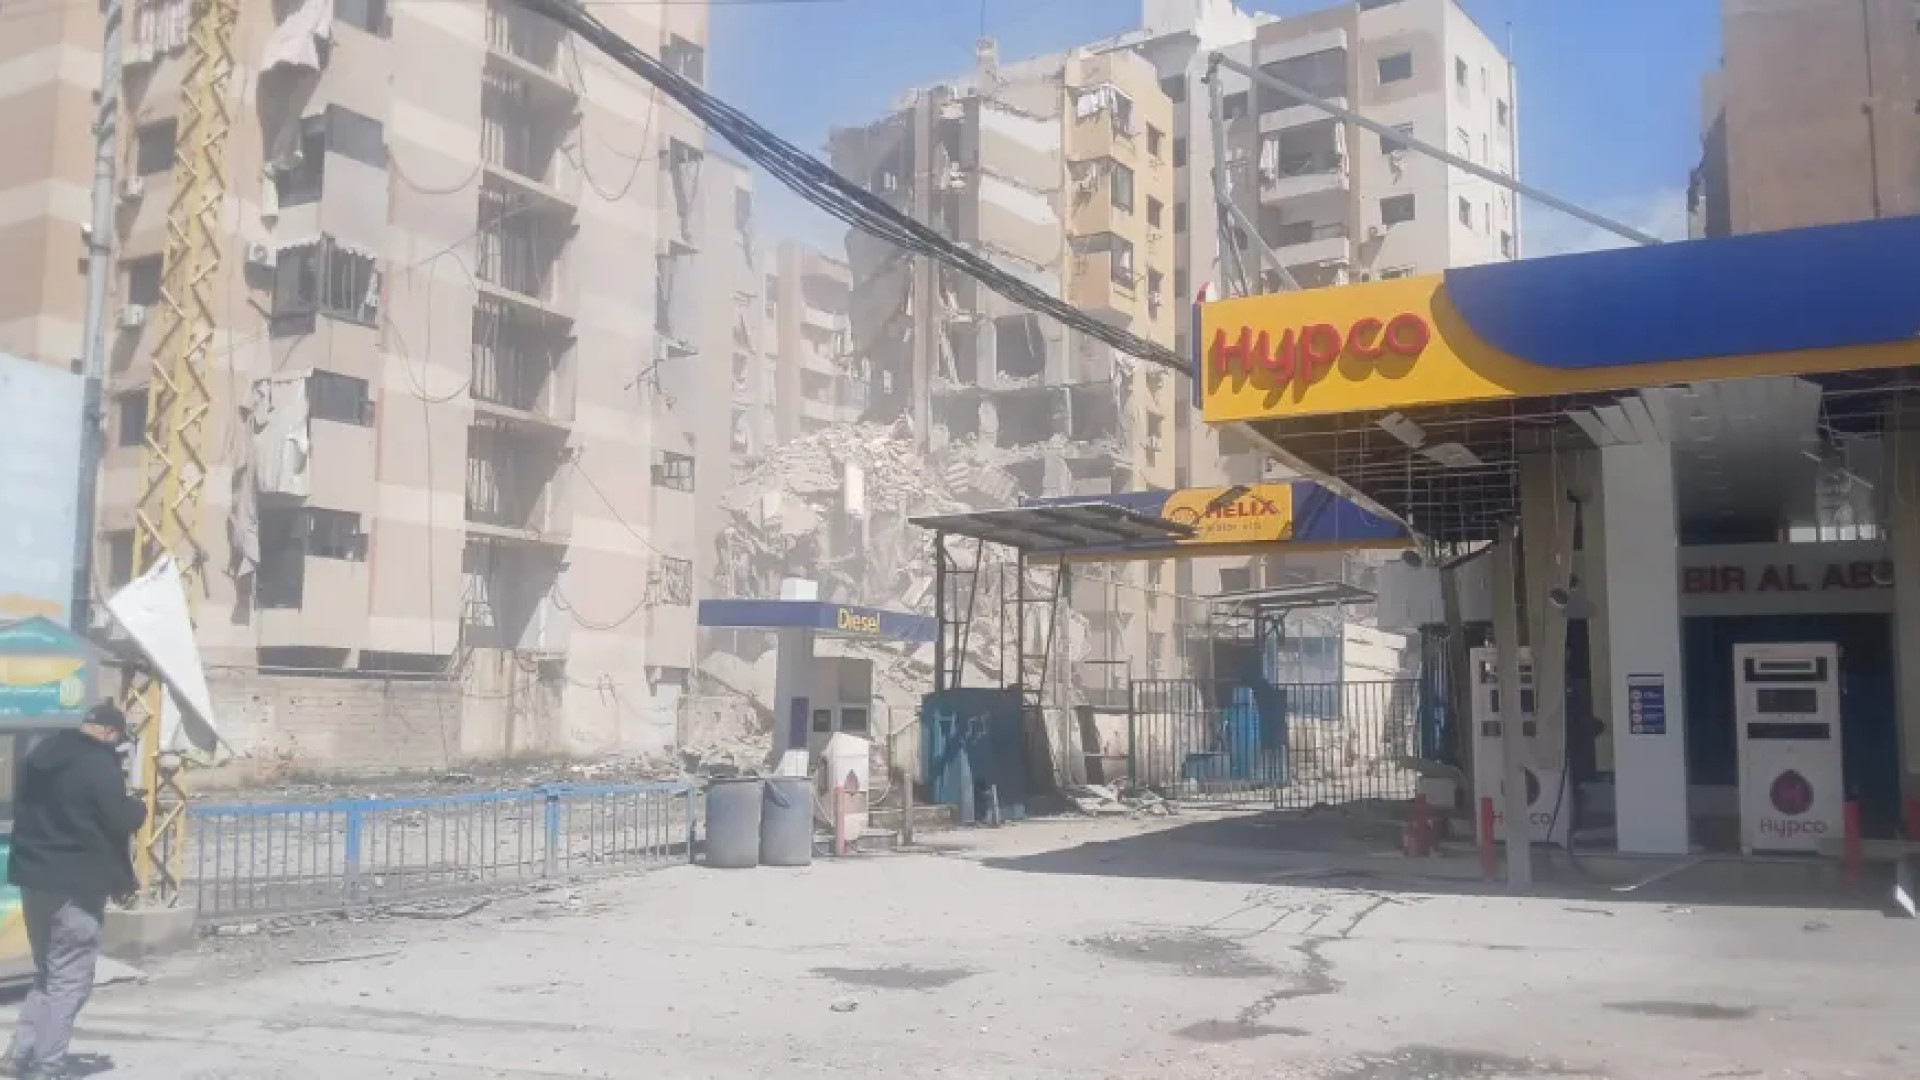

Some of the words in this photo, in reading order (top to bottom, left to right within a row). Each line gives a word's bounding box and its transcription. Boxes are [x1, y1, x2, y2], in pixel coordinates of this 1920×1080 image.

[1215, 312, 1431, 386] Hypco
[1206, 498, 1279, 519] HELIX
[1681, 565, 1746, 593] BIR
[1757, 563, 1811, 591] AL
[838, 607, 881, 632] Diesel
[1760, 819, 1828, 838] Hypco
